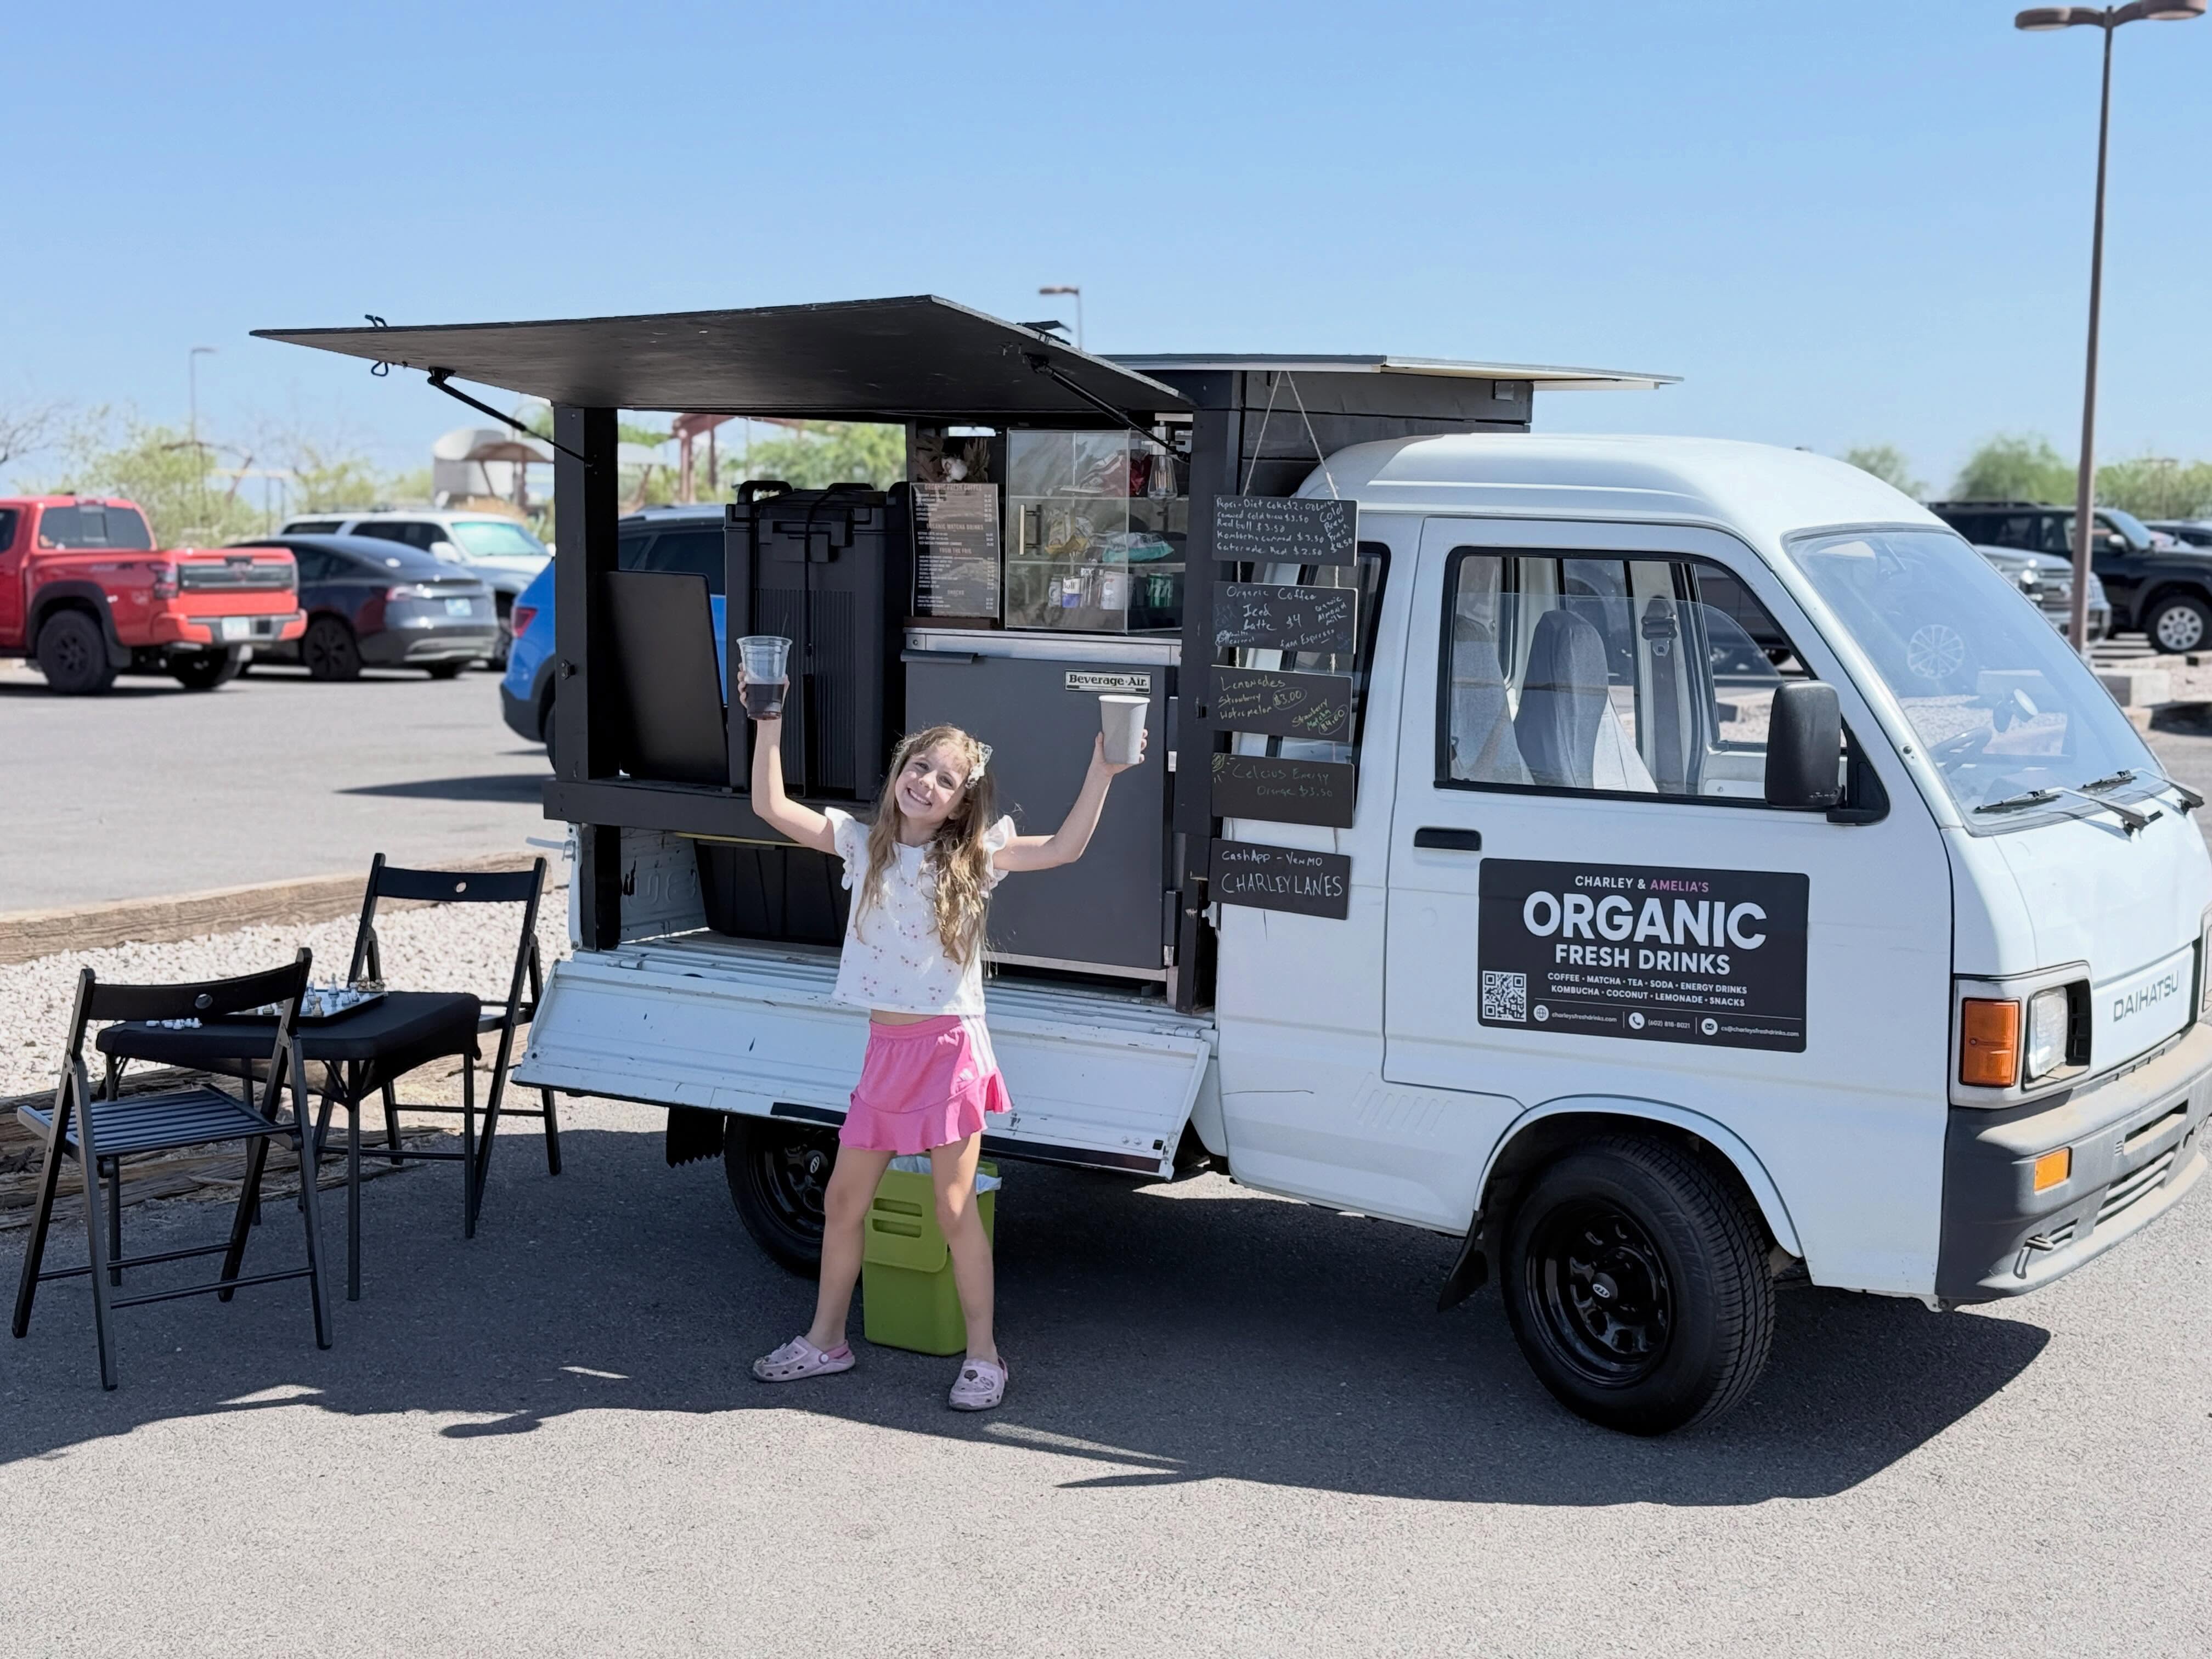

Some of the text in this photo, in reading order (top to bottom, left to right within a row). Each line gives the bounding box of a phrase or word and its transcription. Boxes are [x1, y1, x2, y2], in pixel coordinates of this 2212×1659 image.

[1244, 498, 1263, 507] Diet
[1267, 501, 1287, 510] Coke
[1319, 503, 1343, 522] Cold
[1256, 522, 1285, 533] $3.50
[1324, 515, 1344, 533] Brew
[1297, 532, 1324, 544] $3.50
[1293, 545, 1323, 556] $2.50
[1227, 586, 1316, 601] Organic Coffee
[1243, 603, 1272, 617] Iced
[1243, 613, 1301, 631] Latte $4
[1069, 674, 1124, 686] Beverage
[1273, 690, 1302, 706] $3.00
[1320, 709, 1345, 732] $4.00
[1299, 785, 1333, 798] $3.50
[1575, 876, 1709, 893] CHARLEY & AMELIA'S
[1523, 891, 1767, 950] ORGANIC
[1555, 944, 1730, 975] FRESH DRINKS
[1548, 972, 1747, 994] COFFEE MATCHA TEA SODA ENERGY DRINKS
[1551, 985, 1745, 1007] KOMBUCHA COCONUT LEMONADE SNACKS
[2113, 970, 2179, 1023] DAIHATSU
